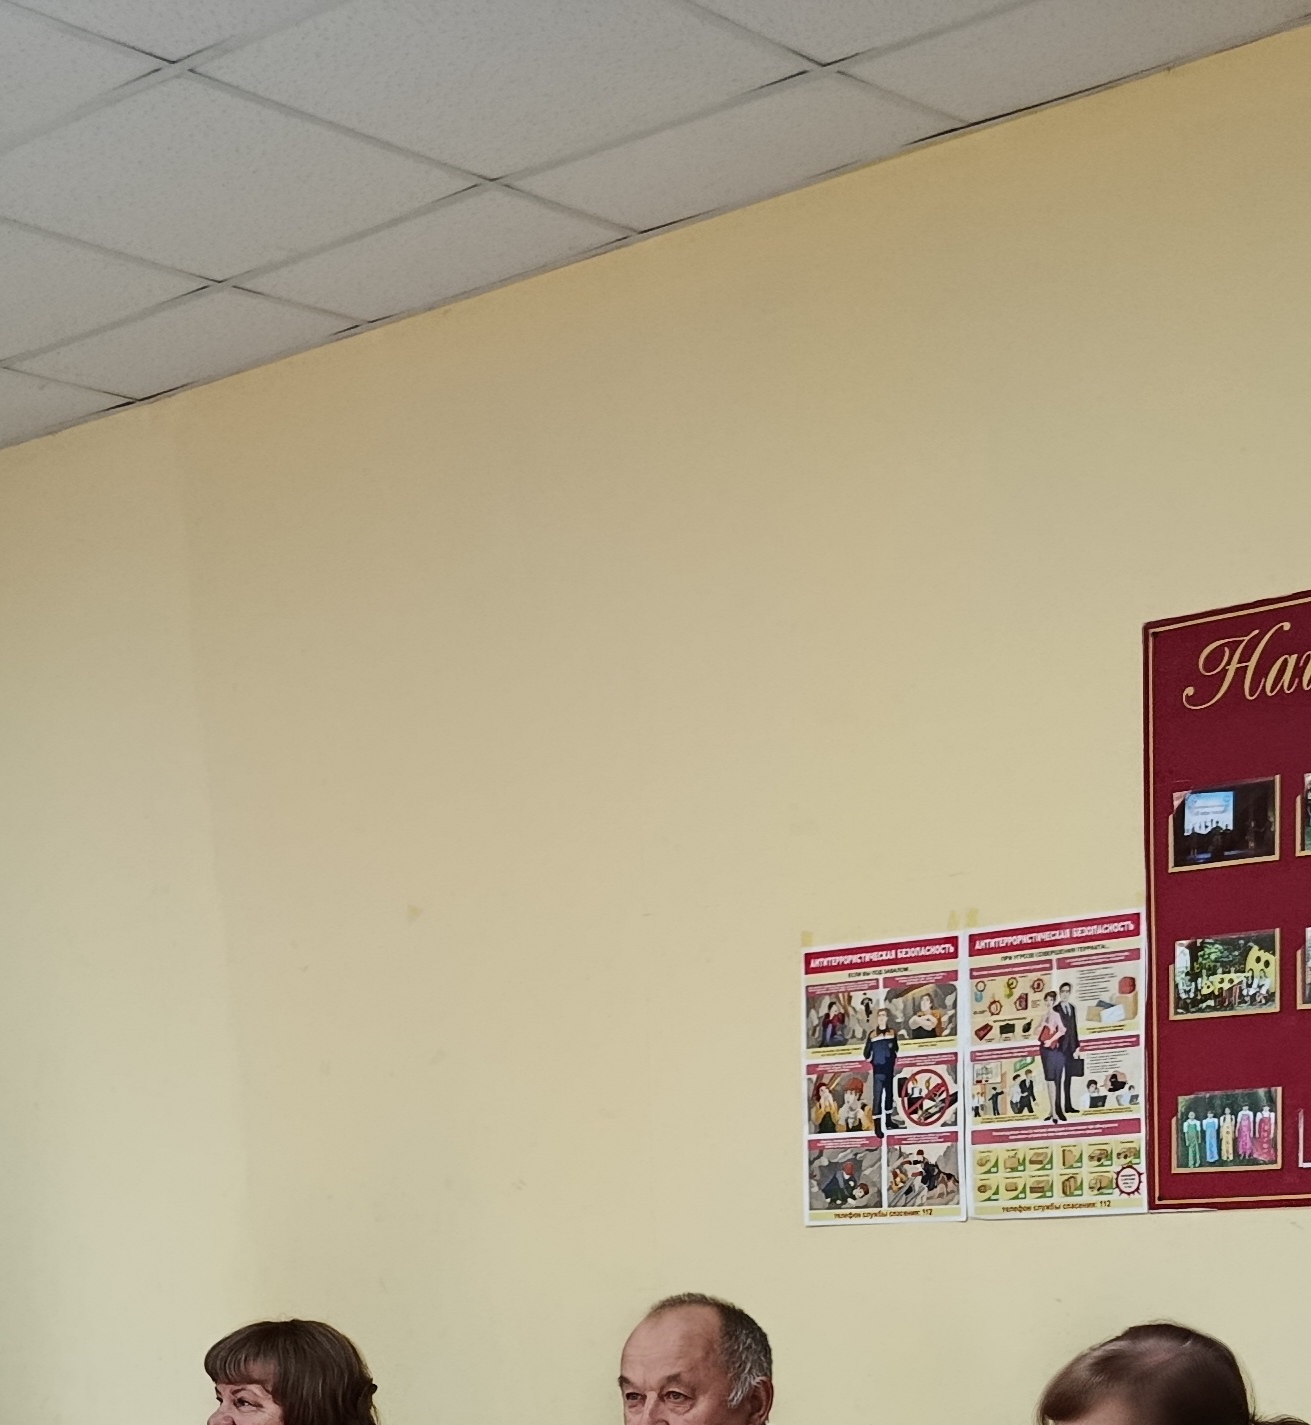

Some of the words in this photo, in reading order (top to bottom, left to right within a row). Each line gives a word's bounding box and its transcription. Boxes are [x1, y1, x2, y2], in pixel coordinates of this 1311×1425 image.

[975, 928, 1071, 950] АНТИТЕРРОРИСТИЧЕСКАЯ
[1072, 921, 1135, 937] БЕЗОПАСНОСТЬ
[810, 949, 896, 968] АНТИТЕРРОРИСТИЧЕСКАЯ
[897, 943, 955, 959] БЕЗОПАСНОСТЬ
[922, 1208, 933, 1216] 112
[1033, 1203, 1061, 1213] службы
[1099, 1200, 1111, 1208] 112
